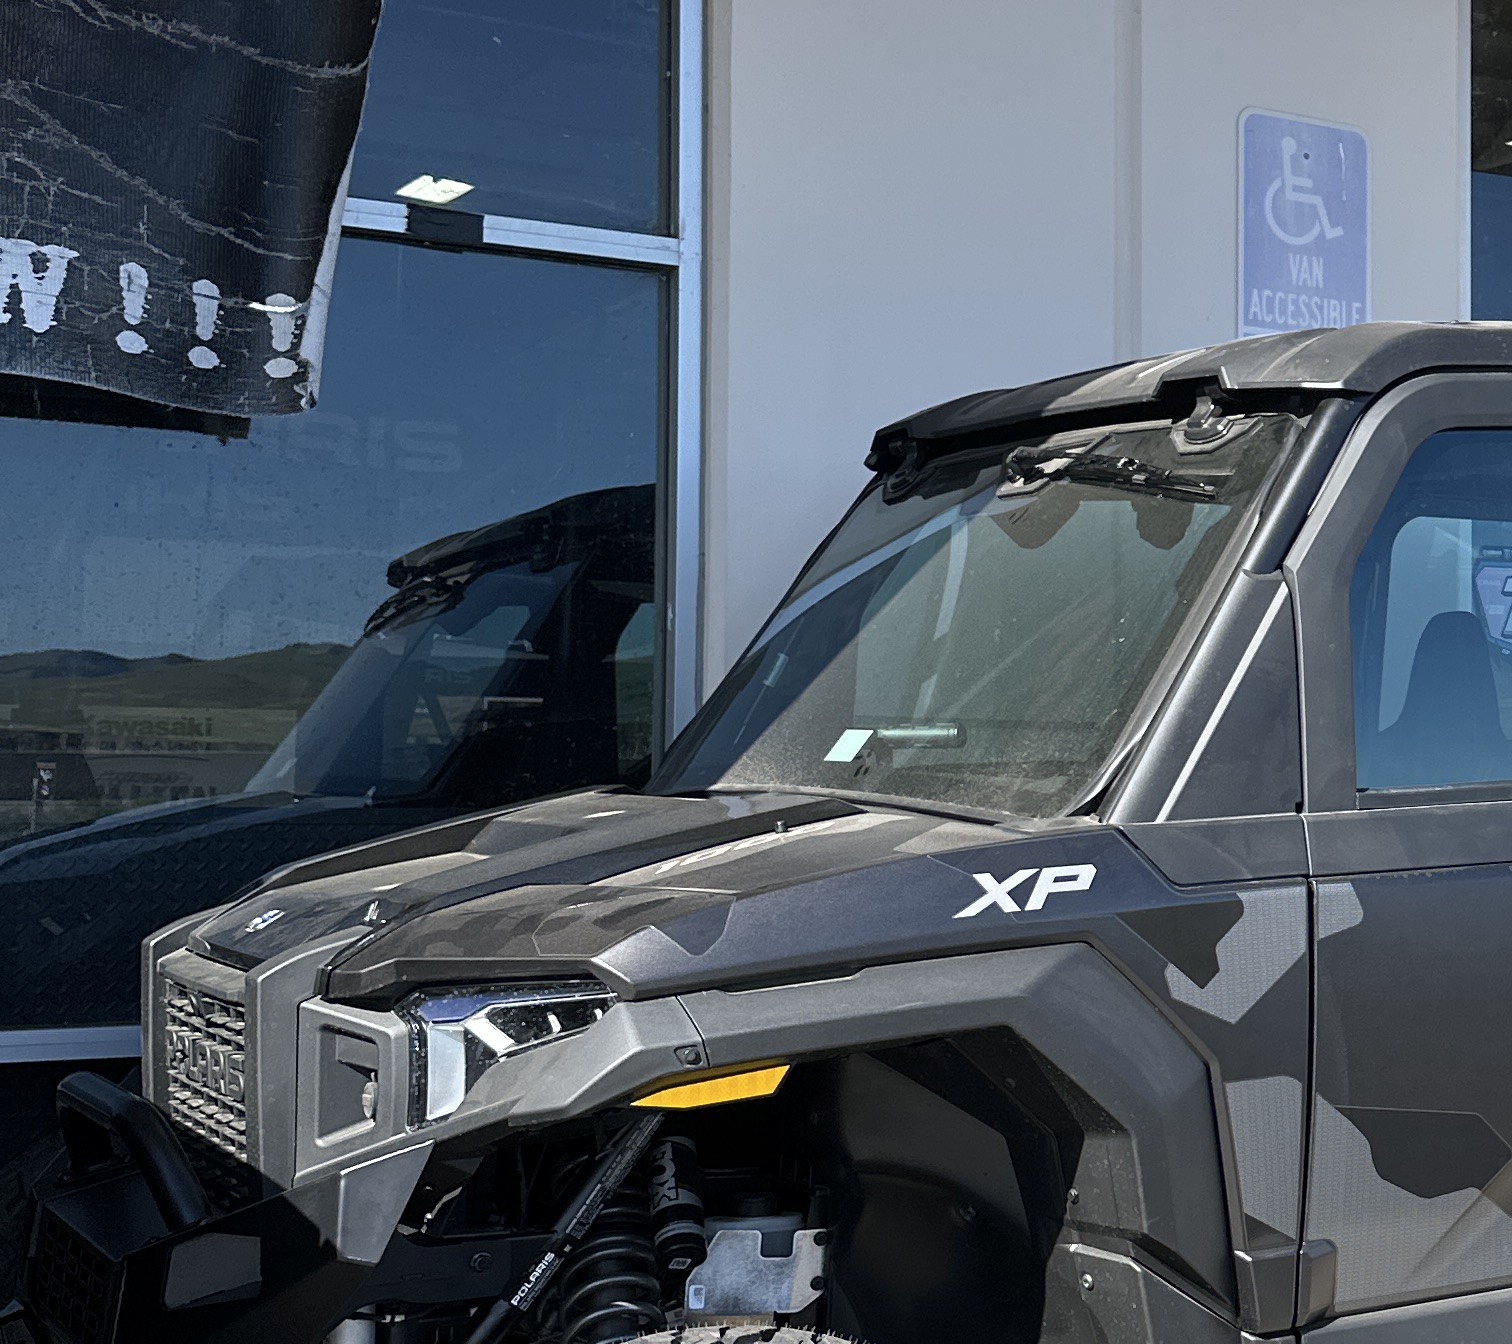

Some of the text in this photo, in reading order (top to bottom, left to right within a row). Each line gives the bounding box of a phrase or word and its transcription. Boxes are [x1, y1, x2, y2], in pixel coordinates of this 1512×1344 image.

[1288, 253, 1324, 288] VAN
[1248, 288, 1362, 329] ACCESSIBLE
[952, 864, 1098, 919] XP
[649, 1141, 680, 1214] FOX
[510, 1251, 555, 1306] POLARIS
